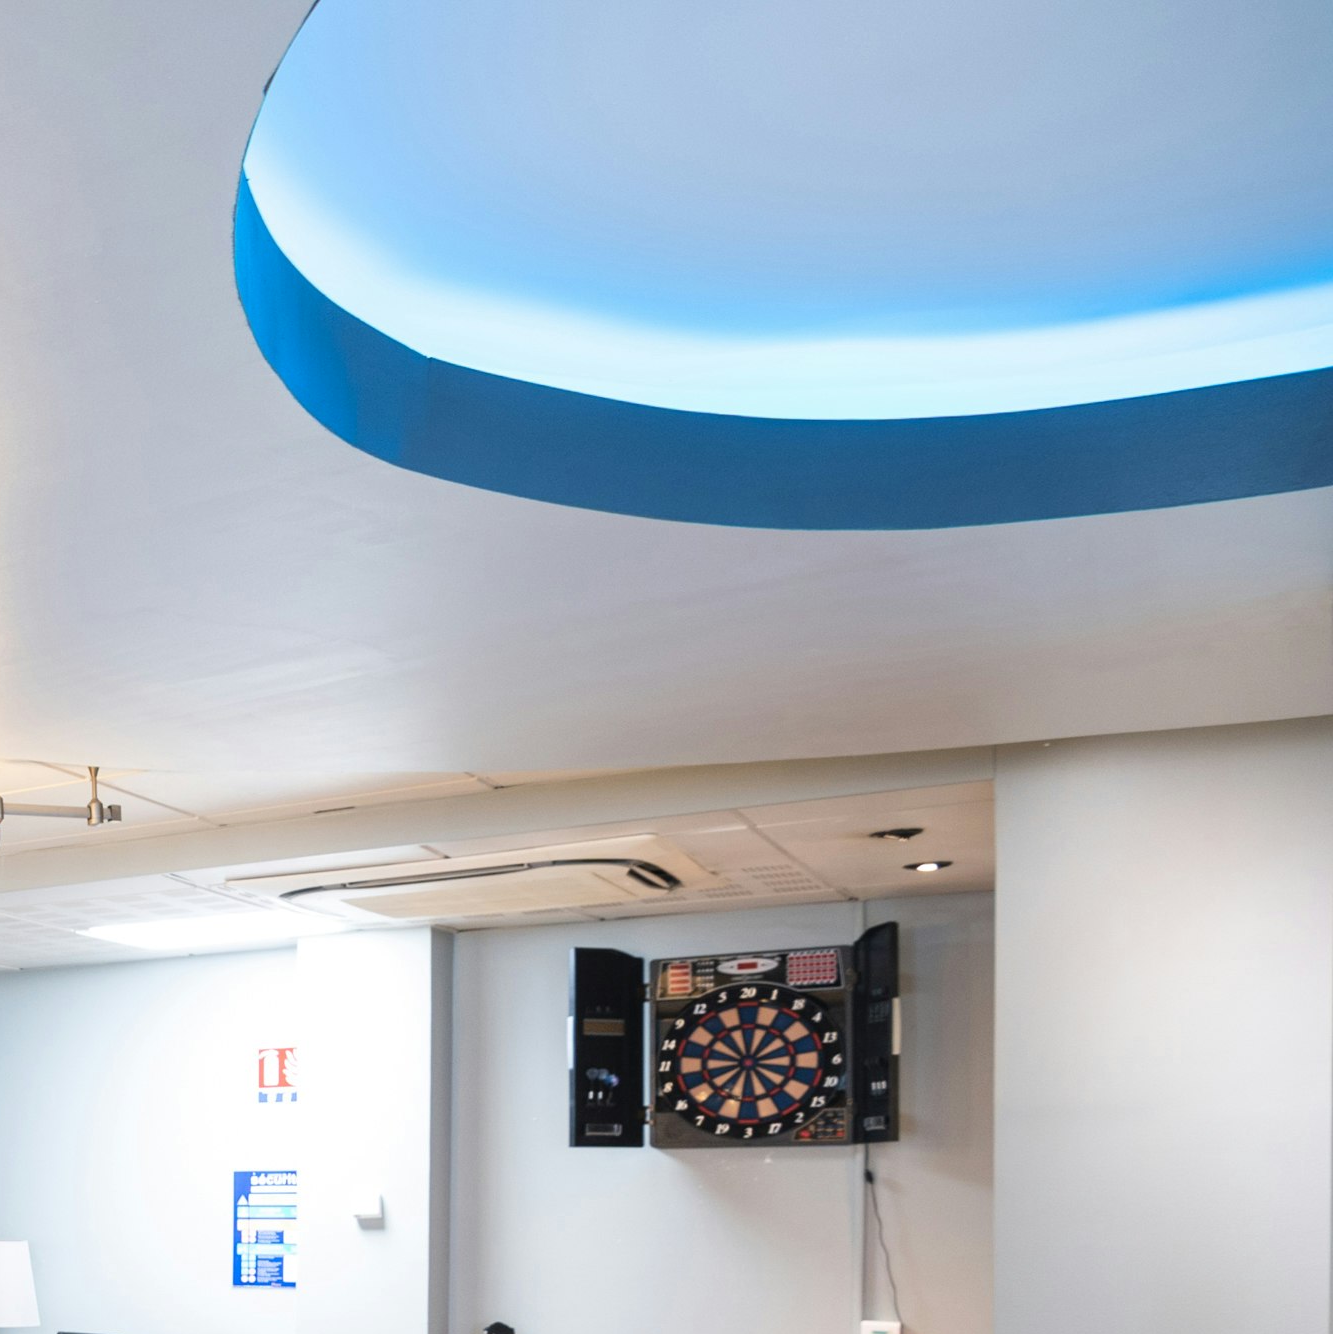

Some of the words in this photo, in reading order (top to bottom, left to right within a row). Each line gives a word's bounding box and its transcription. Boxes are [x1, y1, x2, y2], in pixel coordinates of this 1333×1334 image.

[741, 988, 756, 998] 20
[771, 989, 777, 1000] 1
[694, 1004, 706, 1014] 12
[813, 1012, 821, 1021] 4
[823, 1032, 837, 1043] 13
[662, 1040, 676, 1050] 14
[659, 1061, 671, 1071] 11
[824, 1077, 838, 1087] 10
[696, 1116, 704, 1125] 7
[795, 1113, 803, 1122] 2
[744, 1128, 752, 1138] 3
[768, 1123, 781, 1134] 17
